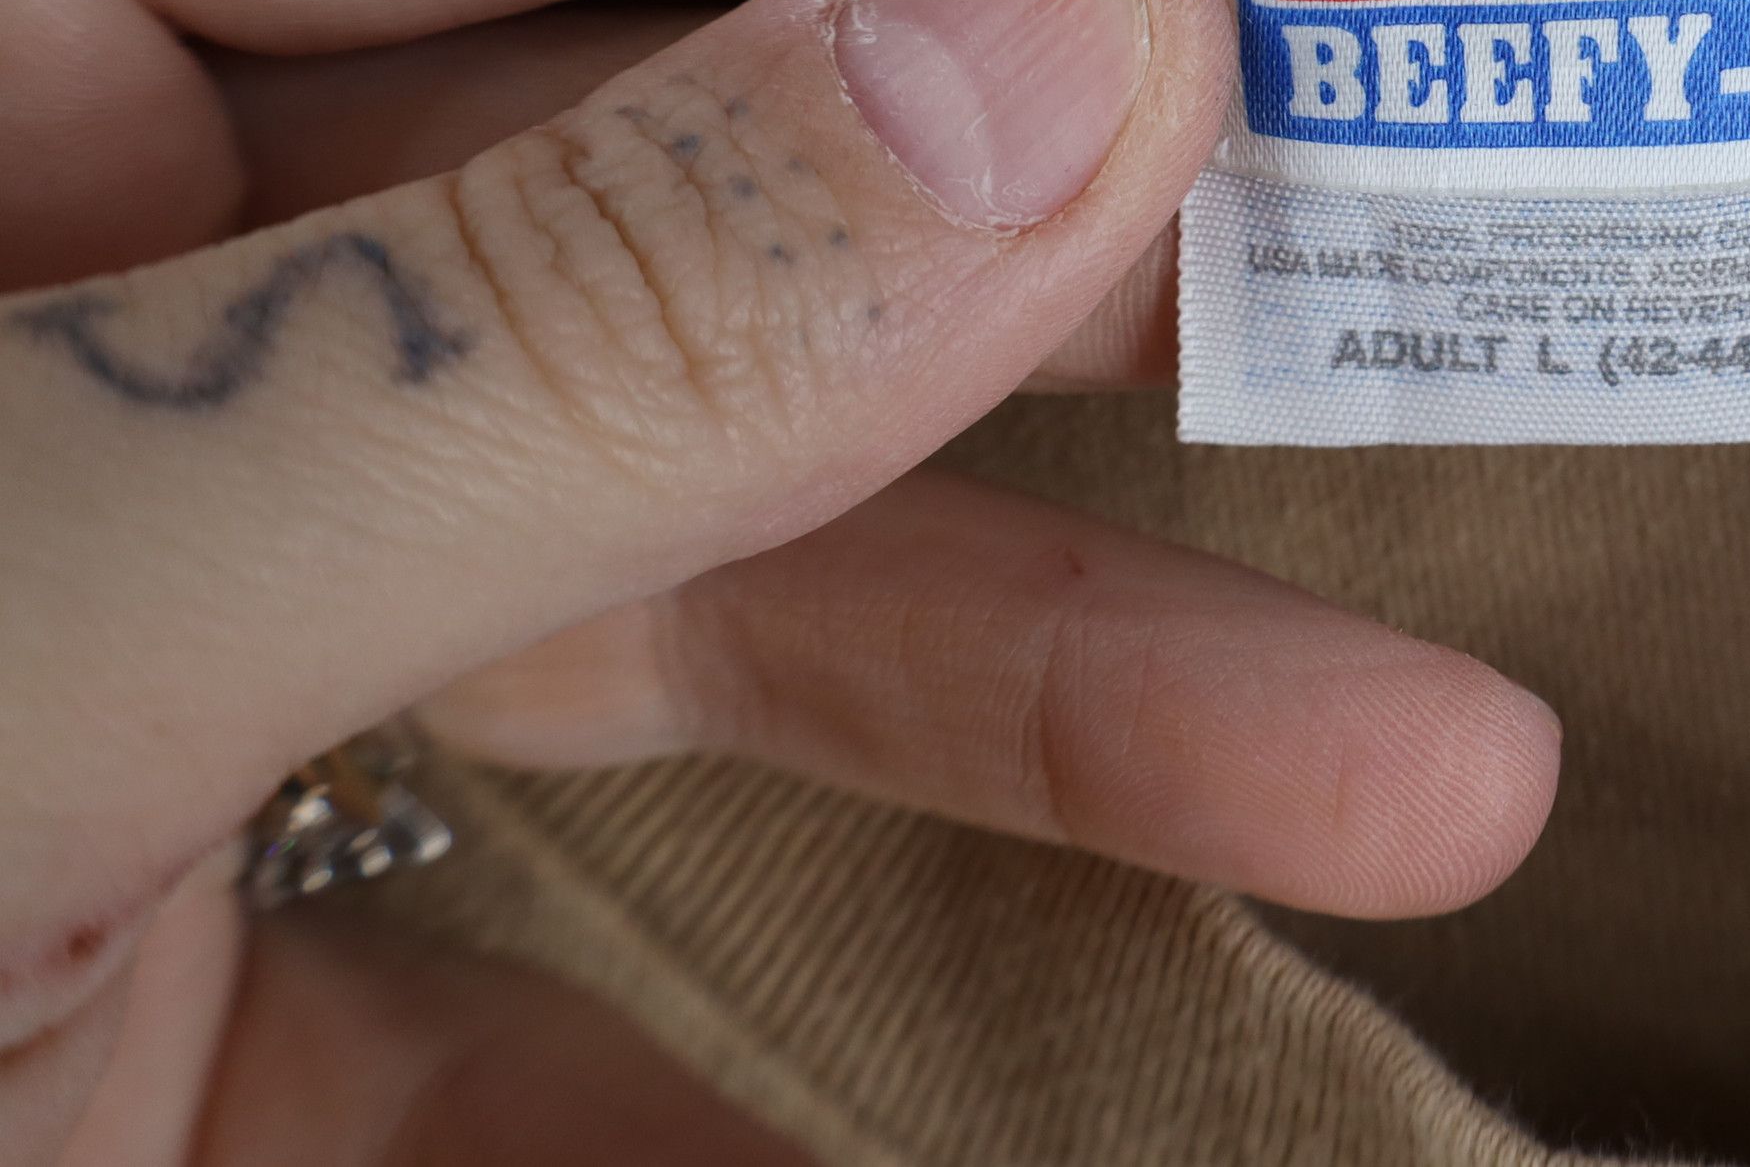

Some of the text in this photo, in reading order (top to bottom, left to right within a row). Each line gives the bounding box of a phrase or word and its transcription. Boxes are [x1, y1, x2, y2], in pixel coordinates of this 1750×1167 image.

[1455, 293, 1551, 322] CARE
[1561, 293, 1616, 323] ON
[1330, 329, 1508, 374] ADULT
[1537, 334, 1573, 375] L
